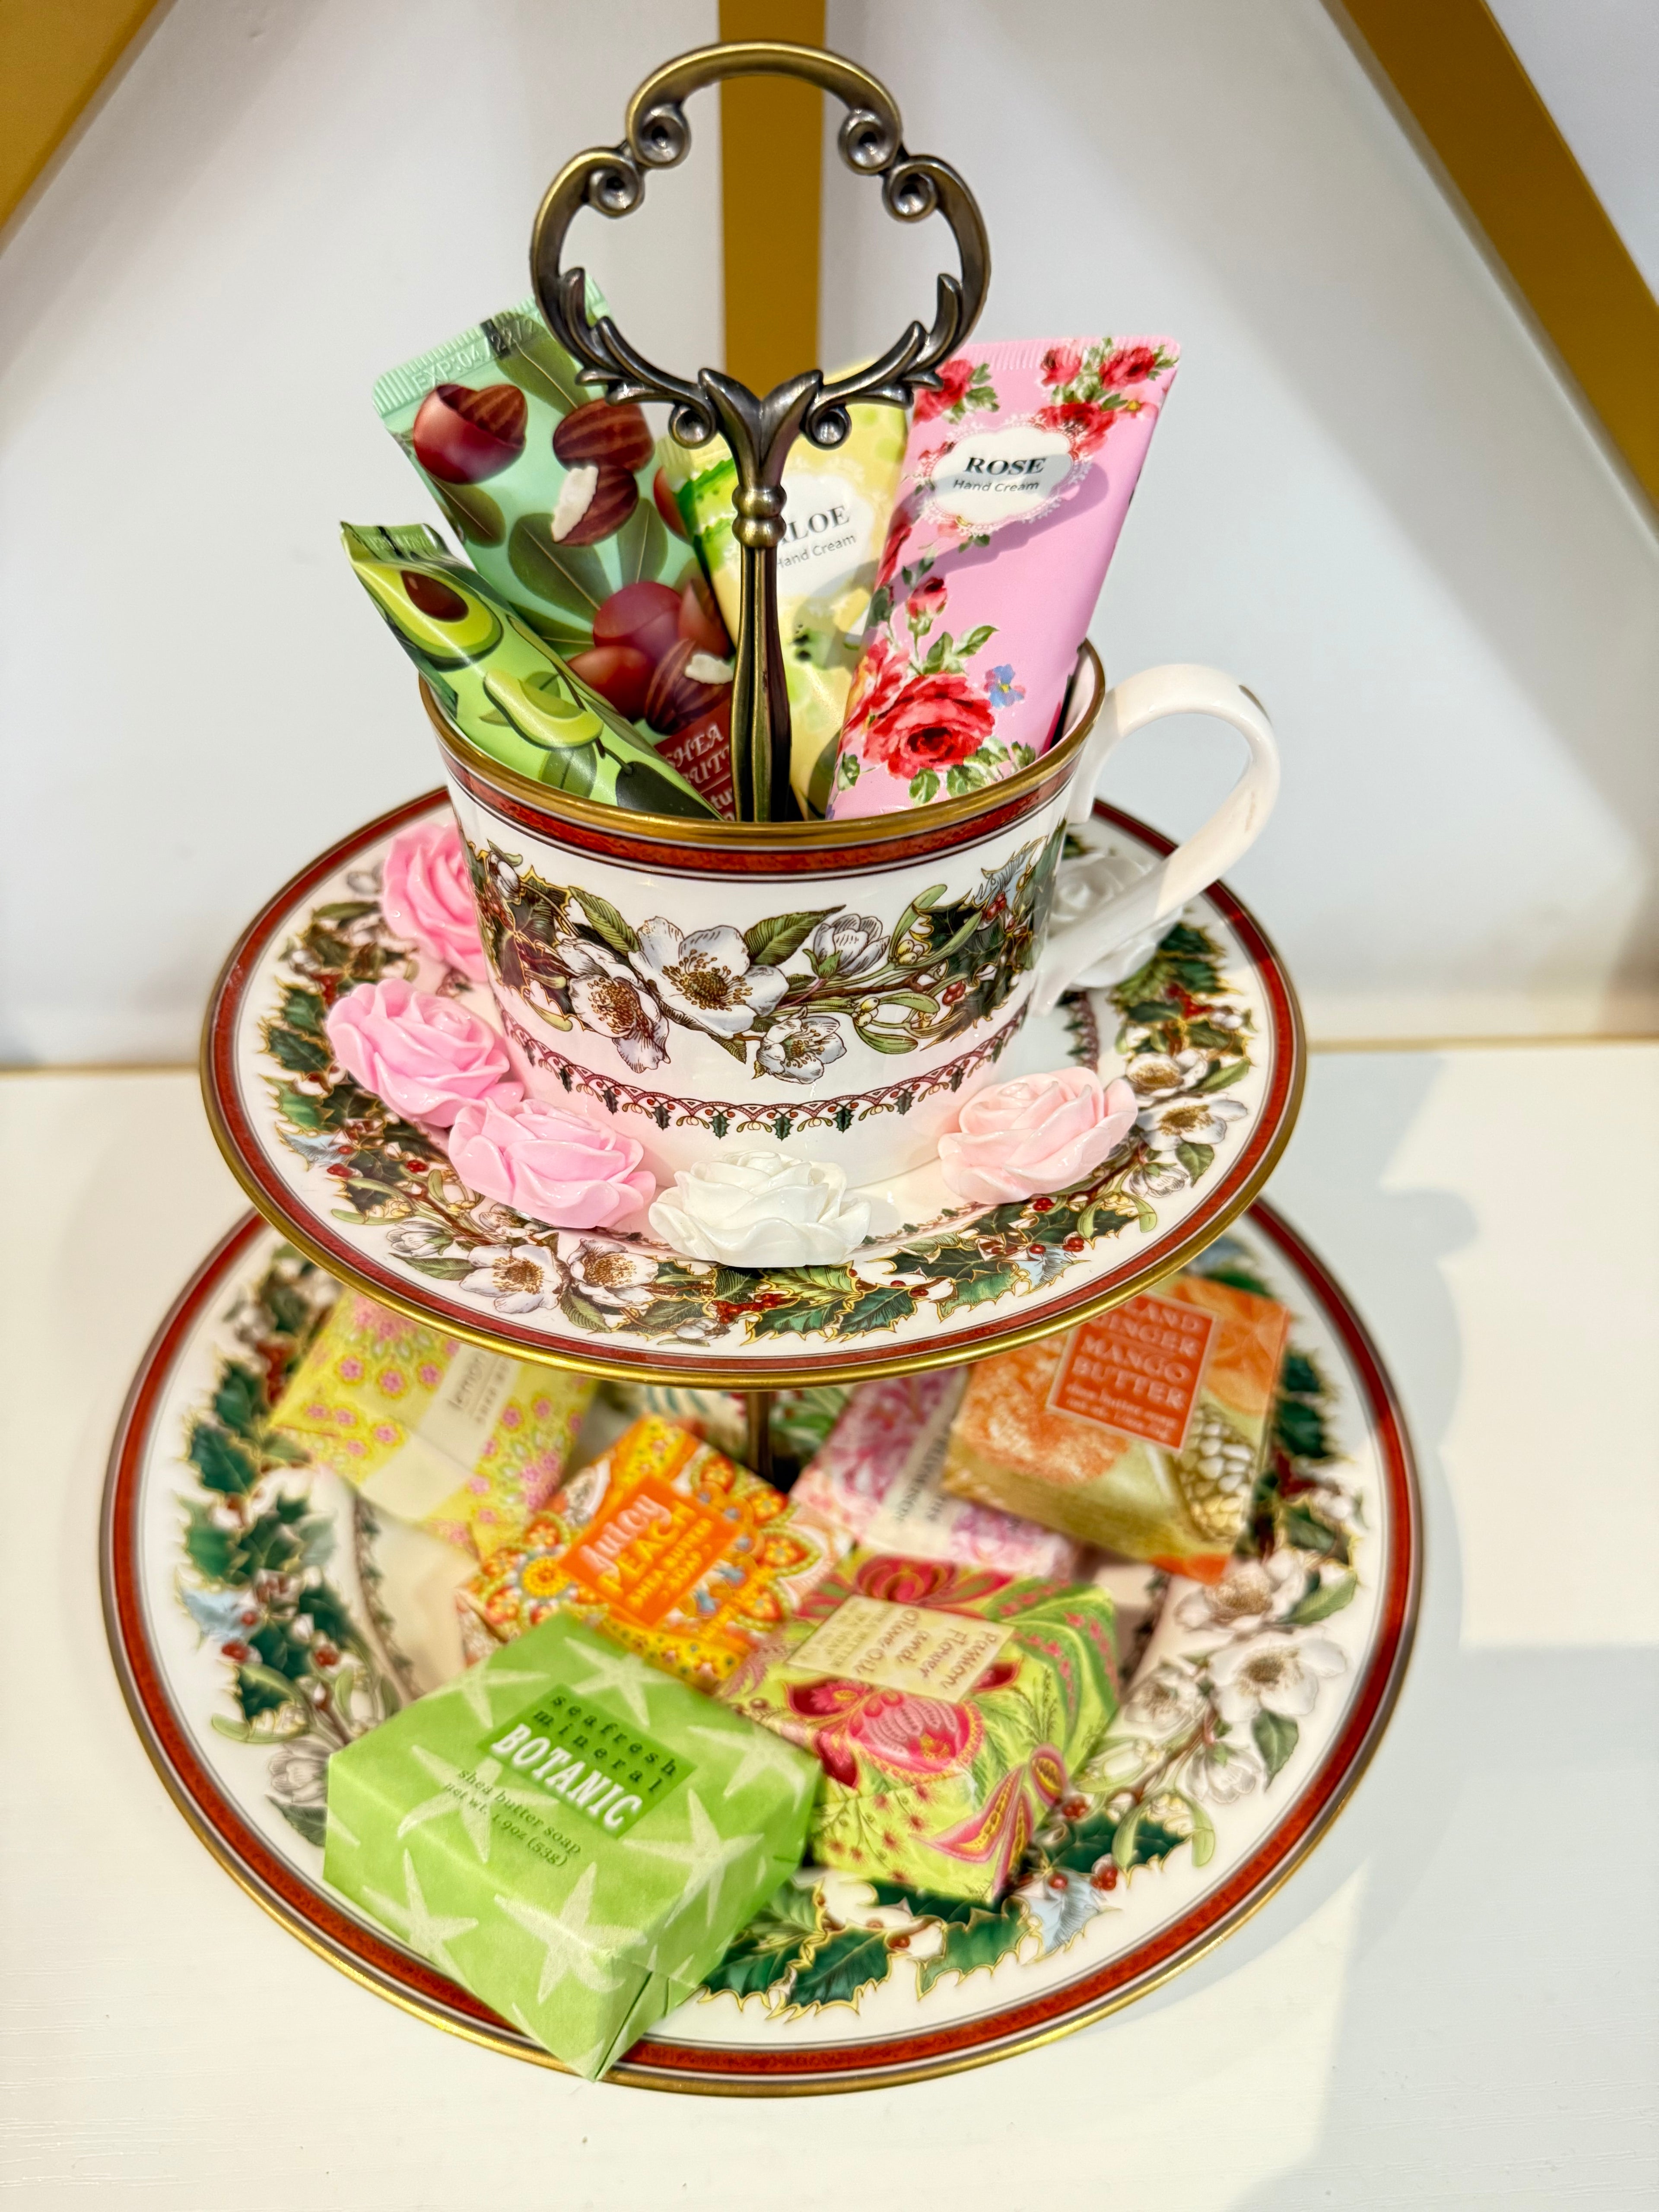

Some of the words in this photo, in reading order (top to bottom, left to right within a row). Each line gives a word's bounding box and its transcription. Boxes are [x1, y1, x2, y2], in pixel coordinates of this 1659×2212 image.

[953, 480, 992, 492] Hand
[995, 482, 1039, 492] Cream
[963, 457, 1047, 475] ROSE
[812, 535, 856, 556] Cream
[1071, 1355, 1187, 1410] BUTTER
[1080, 1334, 1192, 1384] MANGO
[579, 1494, 672, 1580] Juicy
[597, 1500, 697, 1595] PEACH
[877, 1609, 920, 1648] Olive
[896, 1630, 930, 1664] and
[533, 1710, 662, 1792] mineral
[552, 1696, 676, 1777] seafresh
[491, 1723, 643, 1827] BOTANIC
[444, 1782, 468, 1799] net
[527, 1836, 568, 1867] (53g)
[458, 1770, 493, 1795] shea
[495, 1790, 544, 1827] butter
[543, 1826, 581, 1855] soap
